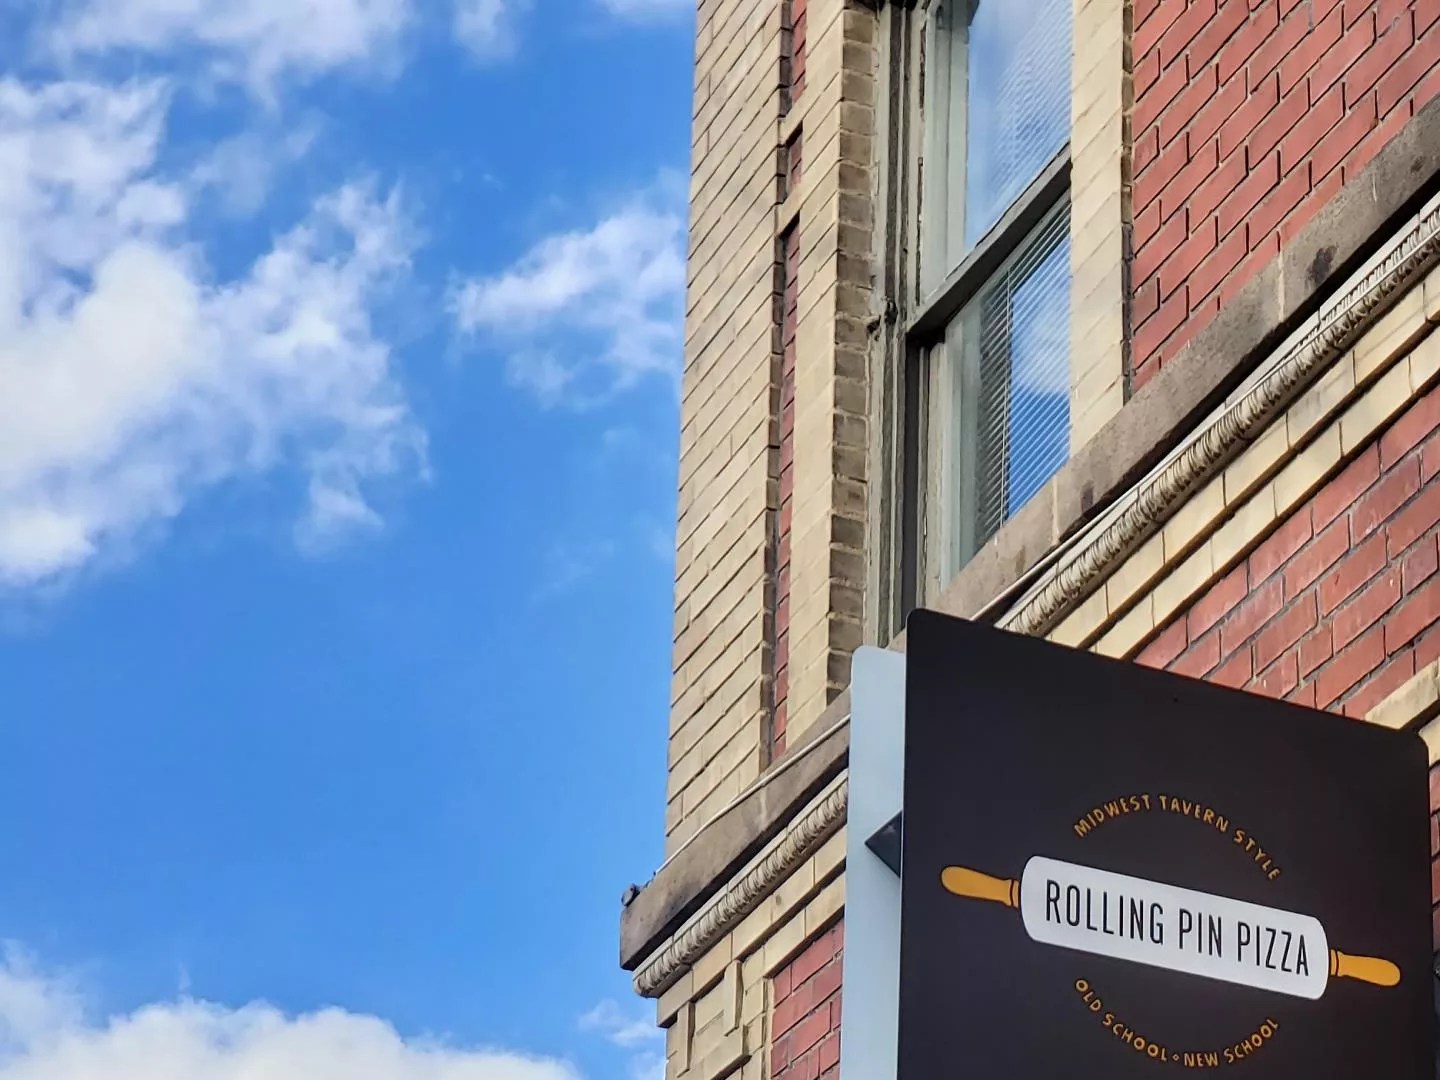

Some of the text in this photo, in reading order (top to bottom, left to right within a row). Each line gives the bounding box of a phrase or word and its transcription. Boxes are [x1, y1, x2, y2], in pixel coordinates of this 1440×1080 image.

[1073, 793, 1281, 881] MIDWEST TAVERN STYLE
[1045, 879, 1310, 977] ROLLING PIN PIZZA
[1075, 978, 1279, 1068] OLD SCHOOL NEW SCHOOL
